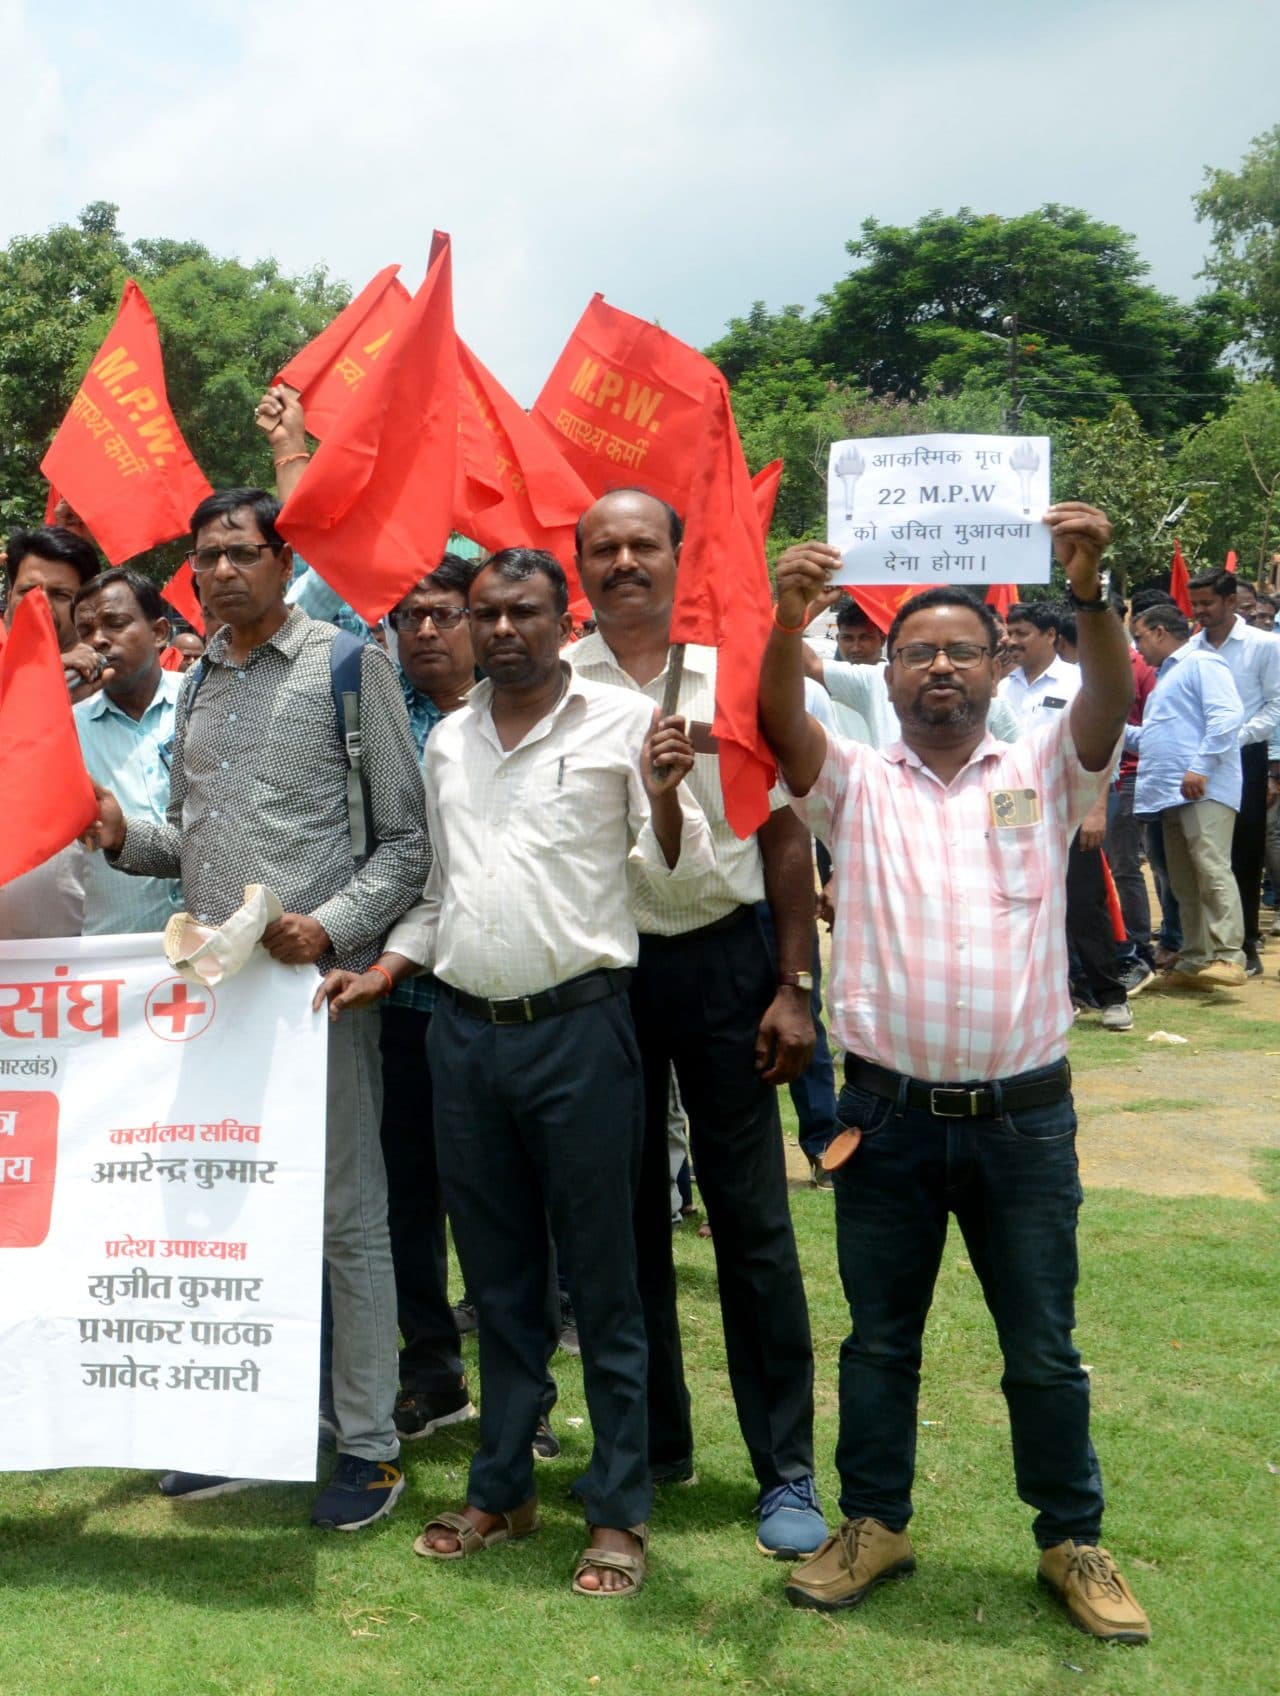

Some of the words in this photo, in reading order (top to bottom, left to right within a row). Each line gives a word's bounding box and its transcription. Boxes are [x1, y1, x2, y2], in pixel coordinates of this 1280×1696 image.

[92, 346, 176, 466] M.P.W.
[570, 357, 664, 433] M.P.W.
[871, 446, 962, 468] आकस्मिक
[975, 450, 1002, 469] मृत
[878, 488, 906, 505] 22
[919, 484, 996, 504] M.P.W
[853, 521, 878, 541] को
[891, 520, 944, 541] उचित
[954, 522, 1033, 544] मुआवजा
[884, 551, 921, 571] देना
[109, 1121, 196, 1145] कार्यालय
[200, 1118, 262, 1143] सचिव
[90, 1152, 189, 1184] अमरेन्द्र
[192, 1158, 278, 1189] कुमार
[105, 1233, 156, 1260] प्रदेश
[159, 1240, 247, 1261] उपाध्यक्ष
[87, 1266, 173, 1306] सुजीत
[177, 1275, 264, 1308] कुमार
[78, 1318, 185, 1344] प्रभाकर
[190, 1320, 274, 1347] पाठक
[81, 1355, 161, 1391] जावेद
[165, 1358, 261, 1392] अंसारी
